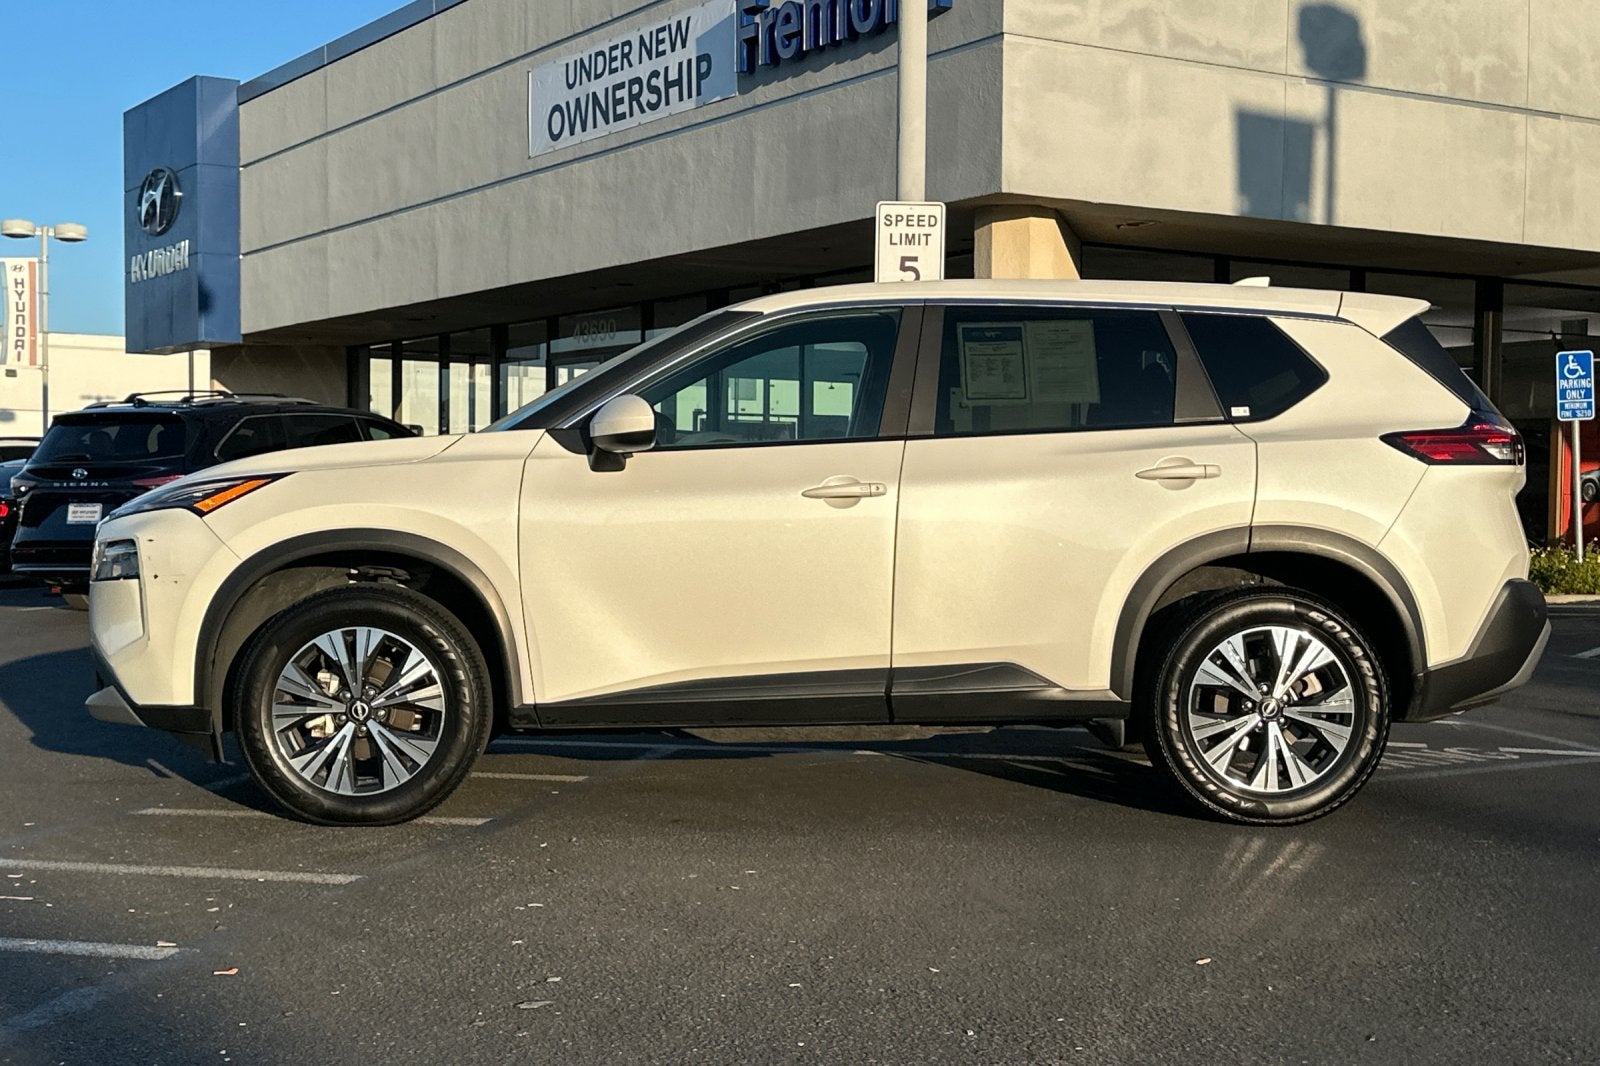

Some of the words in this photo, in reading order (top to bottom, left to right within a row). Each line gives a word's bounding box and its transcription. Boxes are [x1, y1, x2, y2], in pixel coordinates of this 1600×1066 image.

[734, 0, 952, 73] Fremo
[565, 39, 633, 90] UNDER
[638, 16, 691, 65] NEW
[547, 52, 713, 142] OWNERSHIP
[883, 213, 938, 228] SPEED
[889, 232, 932, 247] LIMIT
[131, 239, 189, 283] HYUNDAI
[899, 255, 921, 281] 5
[14, 278, 26, 362] HYUNDAI
[1559, 377, 1592, 390] PARKING
[1565, 389, 1586, 400] ONLY
[1564, 402, 1588, 410] MINIMUM
